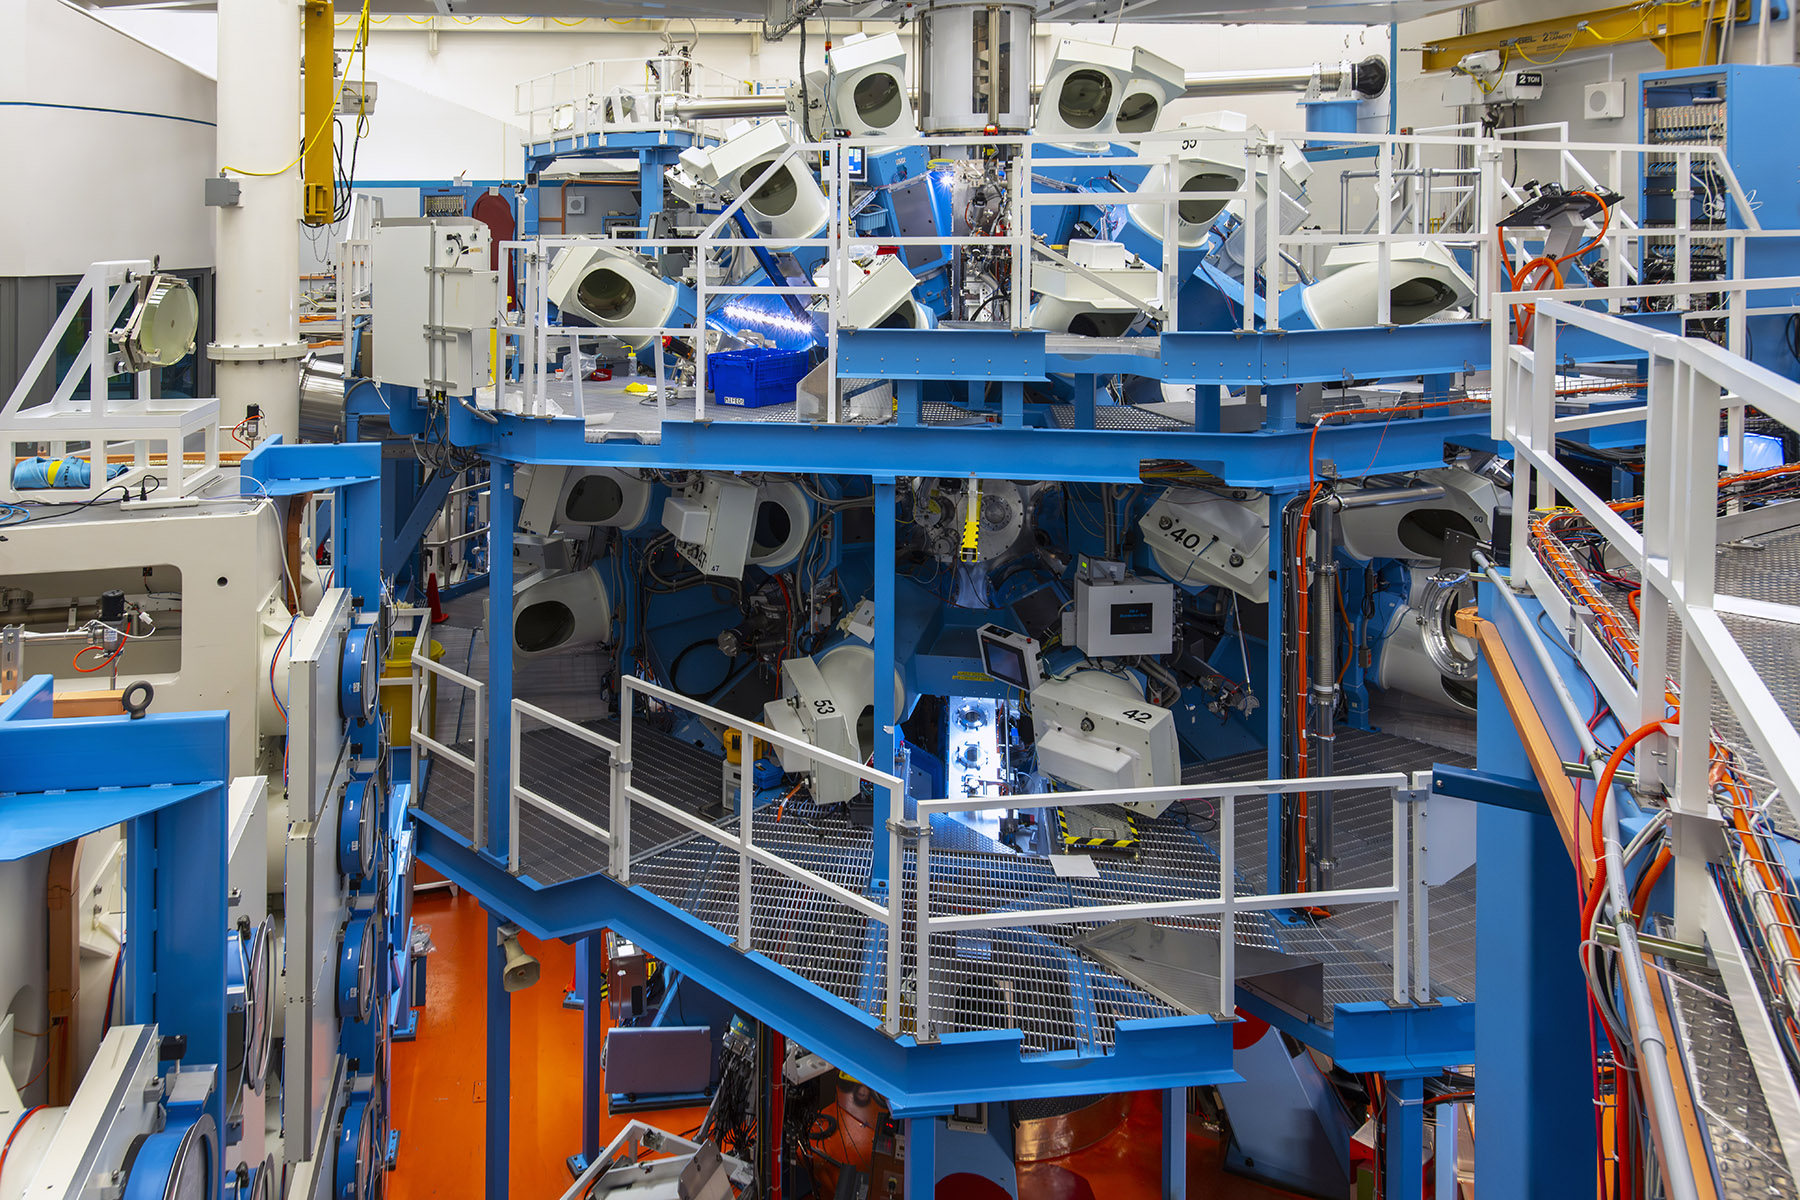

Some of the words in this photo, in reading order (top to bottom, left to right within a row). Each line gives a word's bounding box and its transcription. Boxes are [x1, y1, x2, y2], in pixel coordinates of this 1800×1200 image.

[1542, 32, 1549, 42] 2
[1519, 75, 1526, 84] 2
[1473, 515, 1483, 523] 60
[1170, 528, 1200, 549] 40
[814, 699, 836, 714] 53
[1122, 710, 1152, 724] 42
